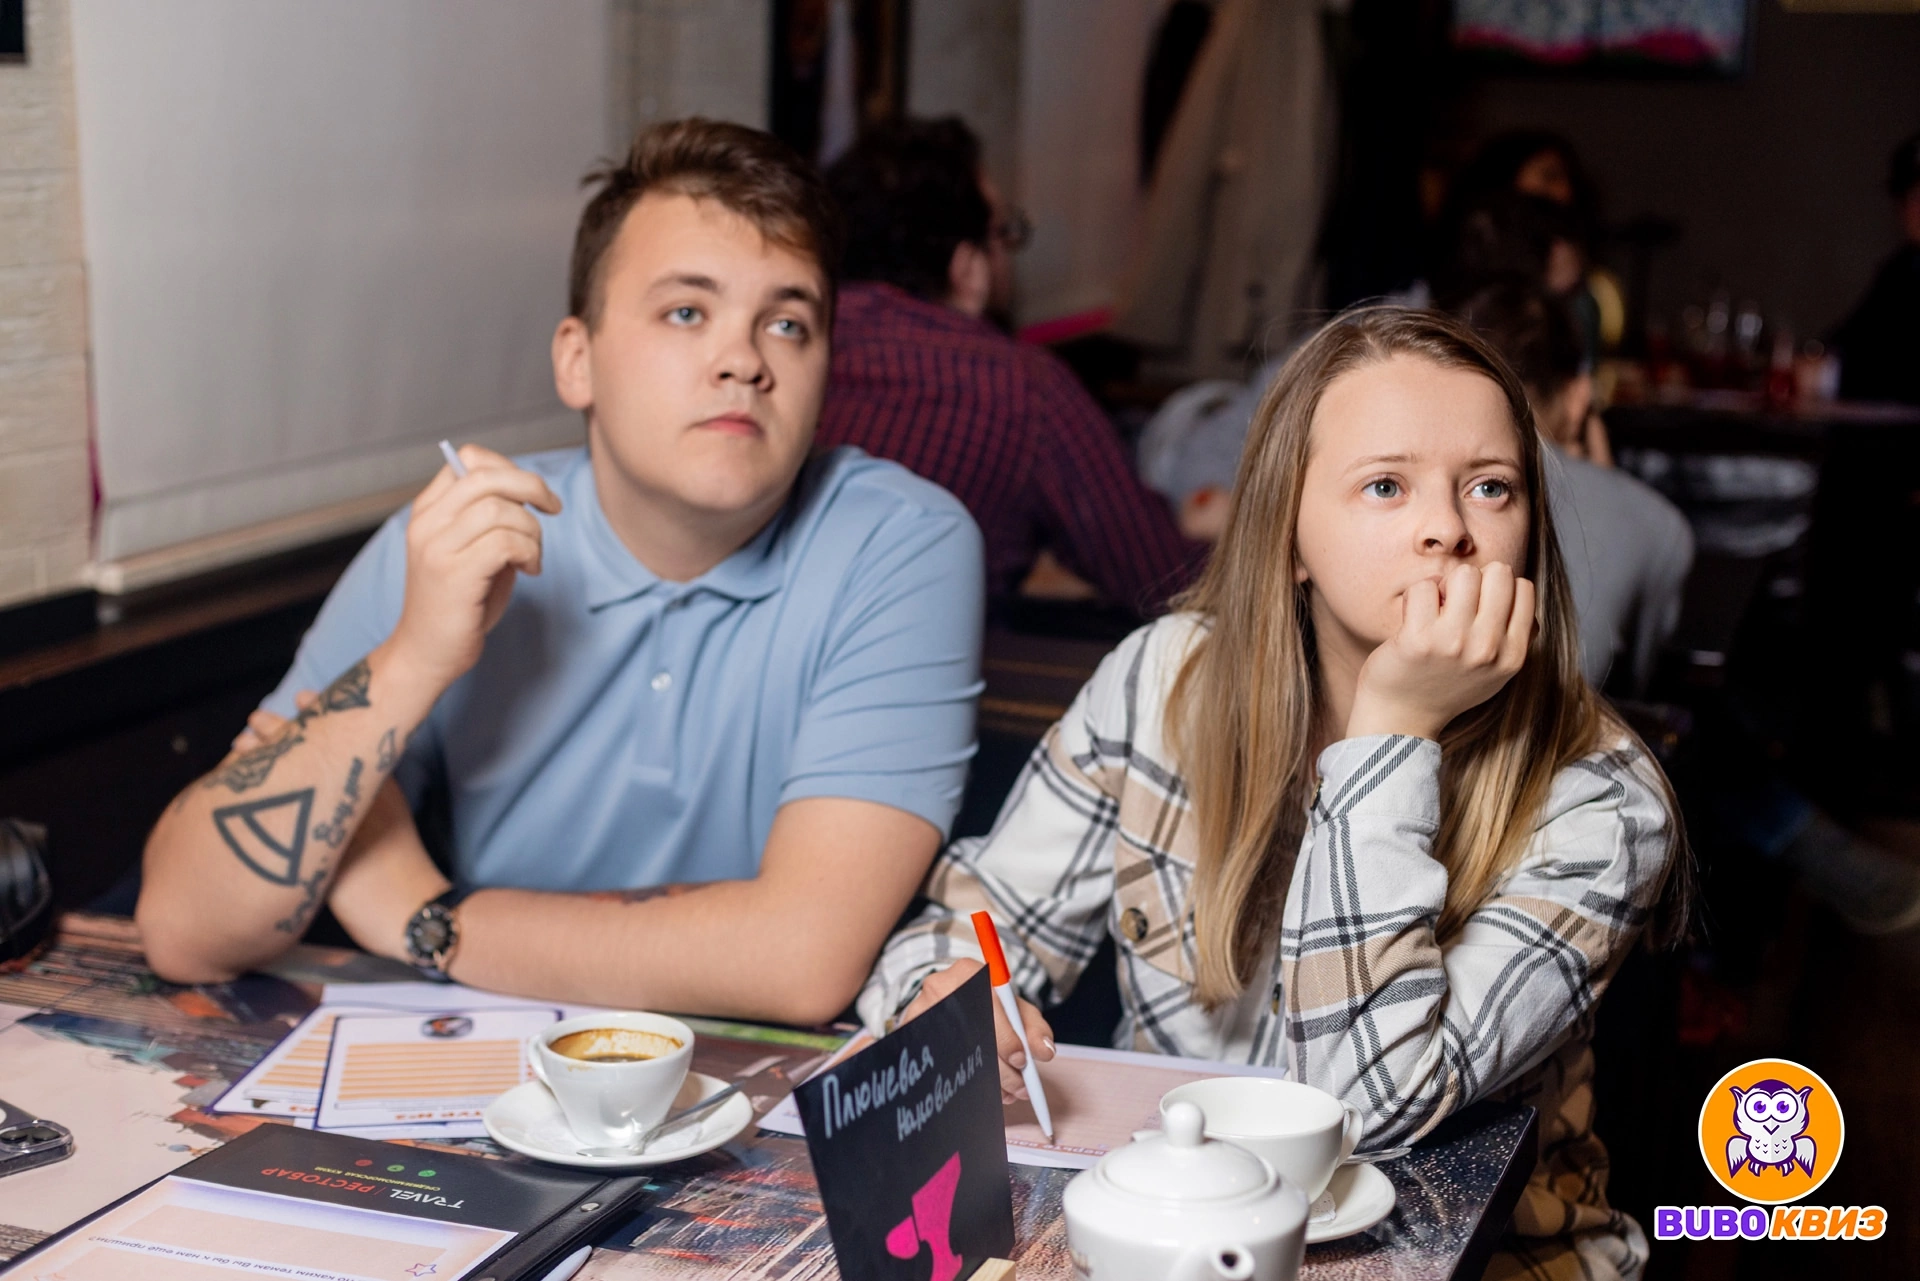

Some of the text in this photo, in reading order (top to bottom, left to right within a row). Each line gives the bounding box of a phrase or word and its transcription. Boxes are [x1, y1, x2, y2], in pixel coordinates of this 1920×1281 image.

[822, 1045, 934, 1139] Плюшевая
[260, 1166, 465, 1209] TRAVEL РЕСТОБАР
[88, 1235, 146, 1250] пришли?
[175, 1250, 201, 1260] нам
[211, 1256, 230, 1265] бы
[231, 1260, 252, 1268] Вы
[253, 1263, 293, 1275] темам
[295, 1269, 336, 1281] каким
